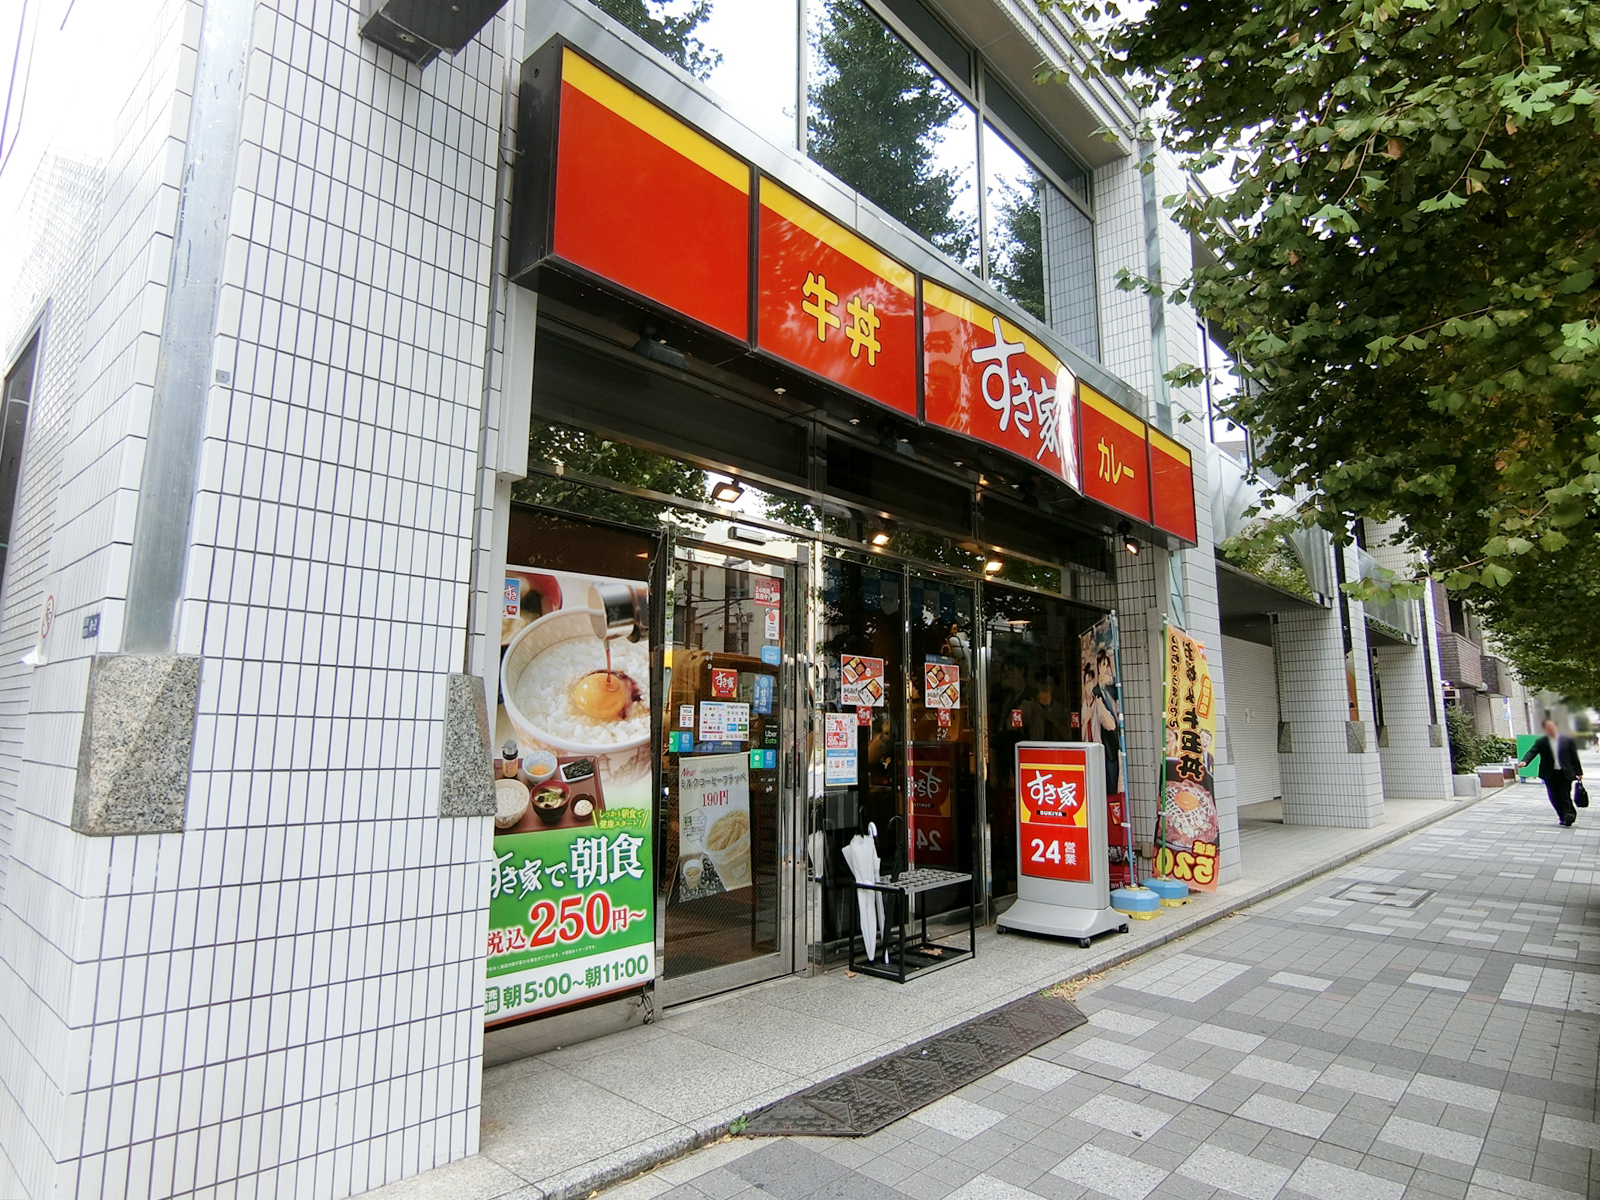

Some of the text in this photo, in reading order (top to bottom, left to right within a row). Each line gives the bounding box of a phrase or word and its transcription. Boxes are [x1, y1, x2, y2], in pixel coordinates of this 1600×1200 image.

[802, 271, 882, 366] 牛丼
[972, 316, 1060, 460] すき家
[1097, 436, 1135, 485] カレー
[715, 671, 735, 690] すき家
[680, 772, 747, 790] ミルクコーヒーフラッペ
[681, 767, 696, 777] New
[702, 789, 729, 807] 190円
[1027, 770, 1078, 810] すき家
[599, 807, 644, 819] しっかり朝食で
[1039, 810, 1063, 818] SUKIYA
[1031, 838, 1061, 864] 24
[490, 833, 645, 900] すき家で朝食
